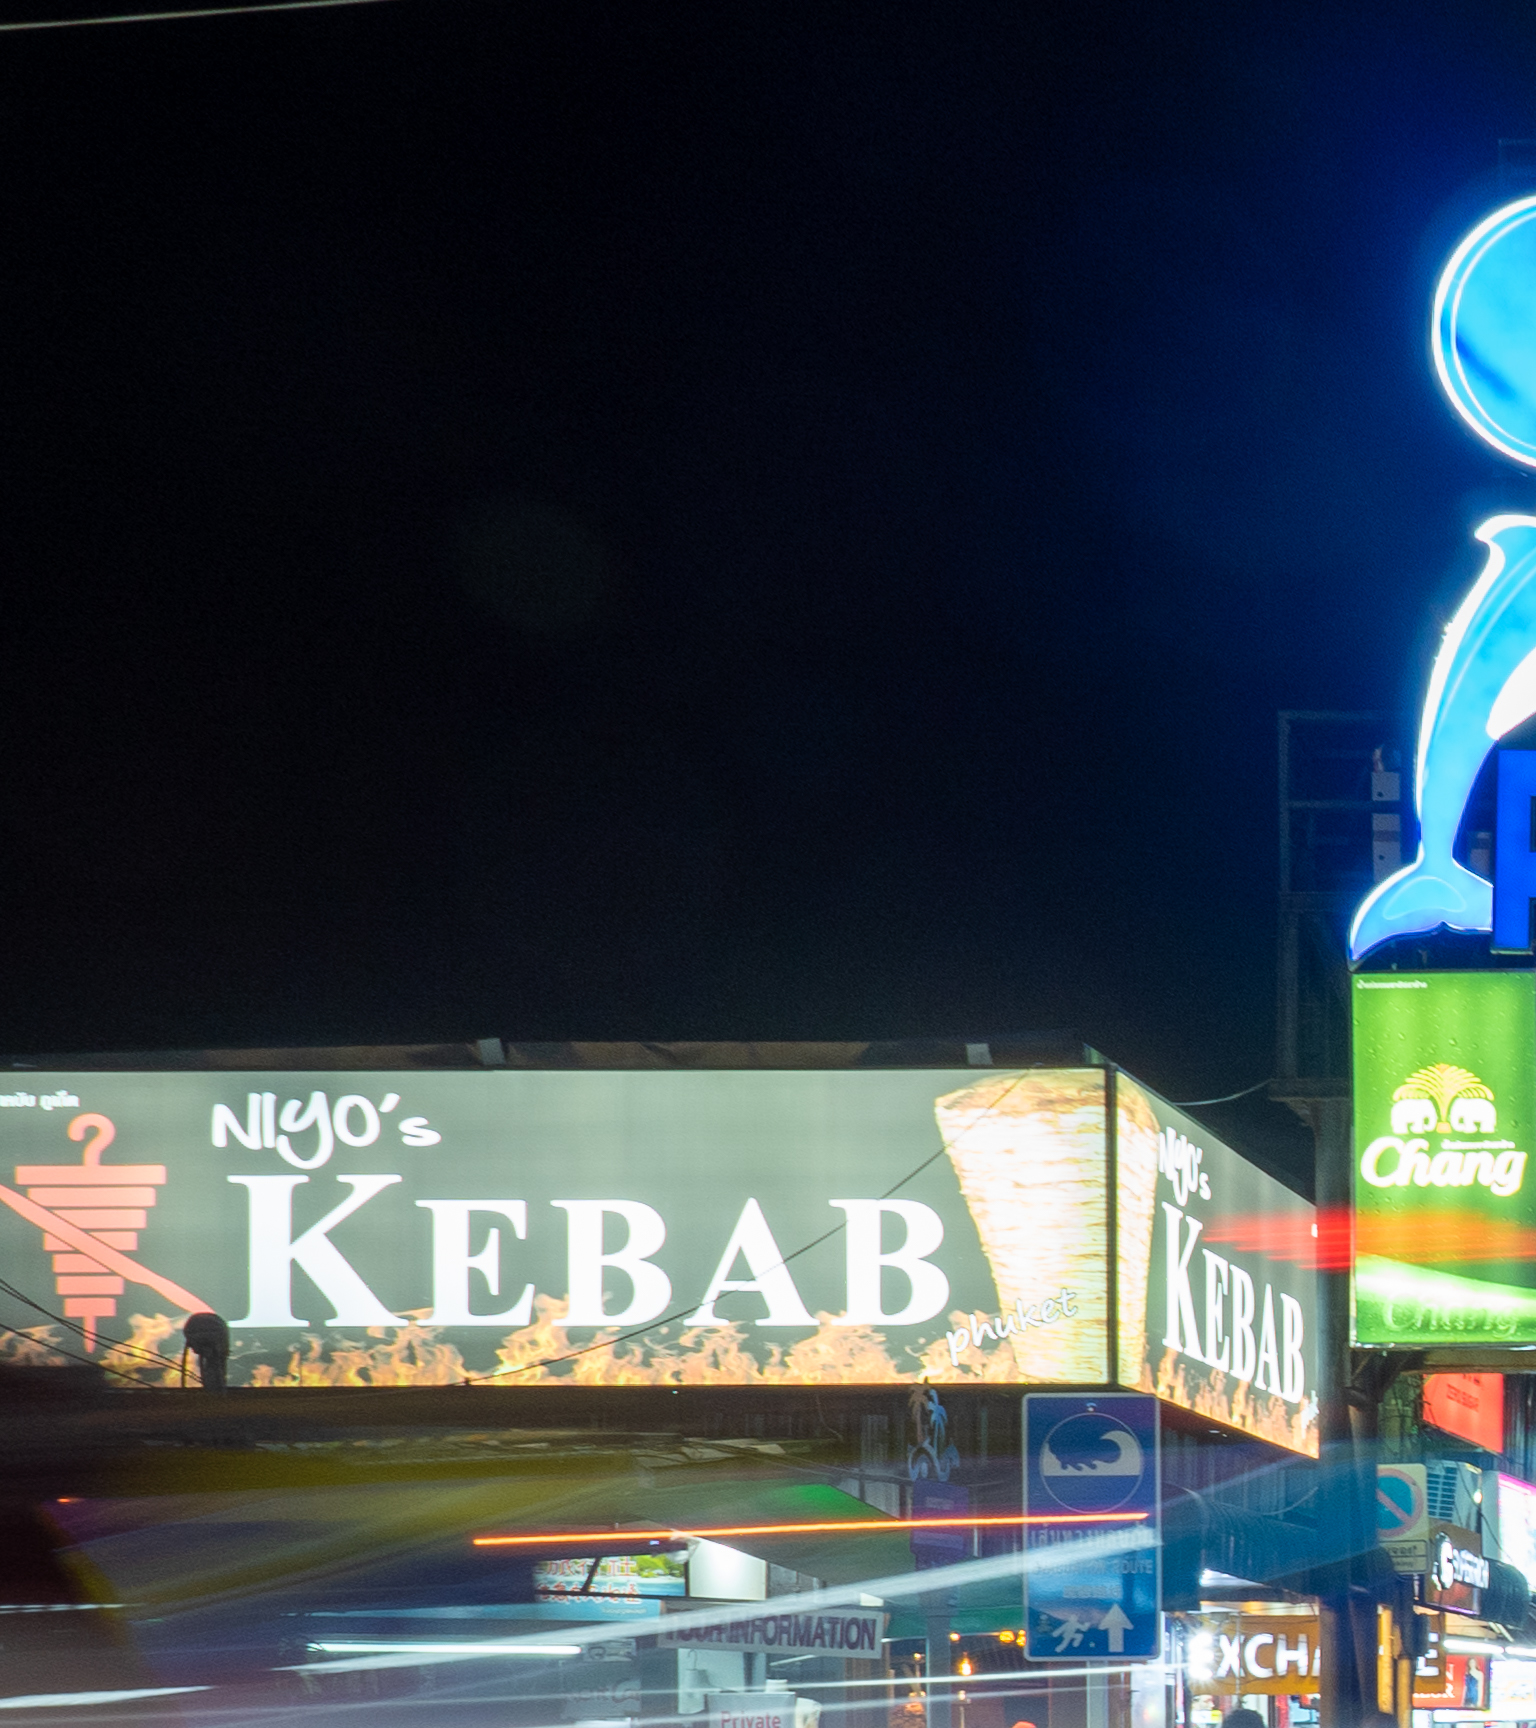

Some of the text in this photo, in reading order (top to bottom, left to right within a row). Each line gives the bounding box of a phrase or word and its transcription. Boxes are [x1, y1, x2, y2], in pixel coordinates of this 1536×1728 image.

[1361, 1136, 1528, 1197] Chang
[226, 1173, 950, 1328] KEBAB
[946, 1287, 1078, 1367] phuket
[1161, 1200, 1306, 1404] KEBAB
[724, 1614, 877, 1651] INFORMATION
